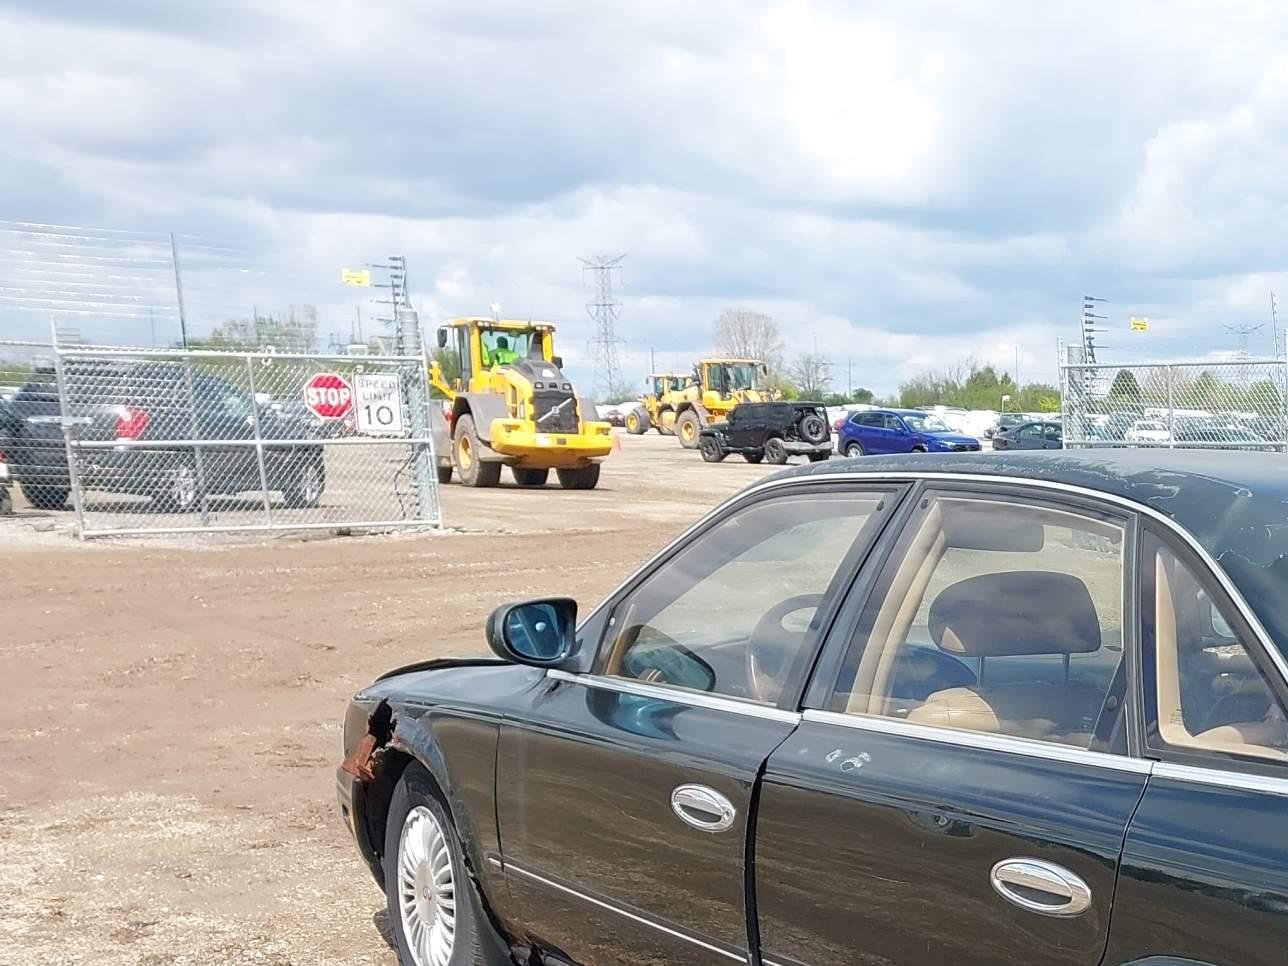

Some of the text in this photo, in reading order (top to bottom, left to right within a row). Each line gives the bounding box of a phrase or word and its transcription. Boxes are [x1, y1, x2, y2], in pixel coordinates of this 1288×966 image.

[358, 378, 396, 389] SPEED
[308, 387, 351, 406] STOP
[362, 390, 393, 401] LIMIT
[364, 404, 394, 426] 10
